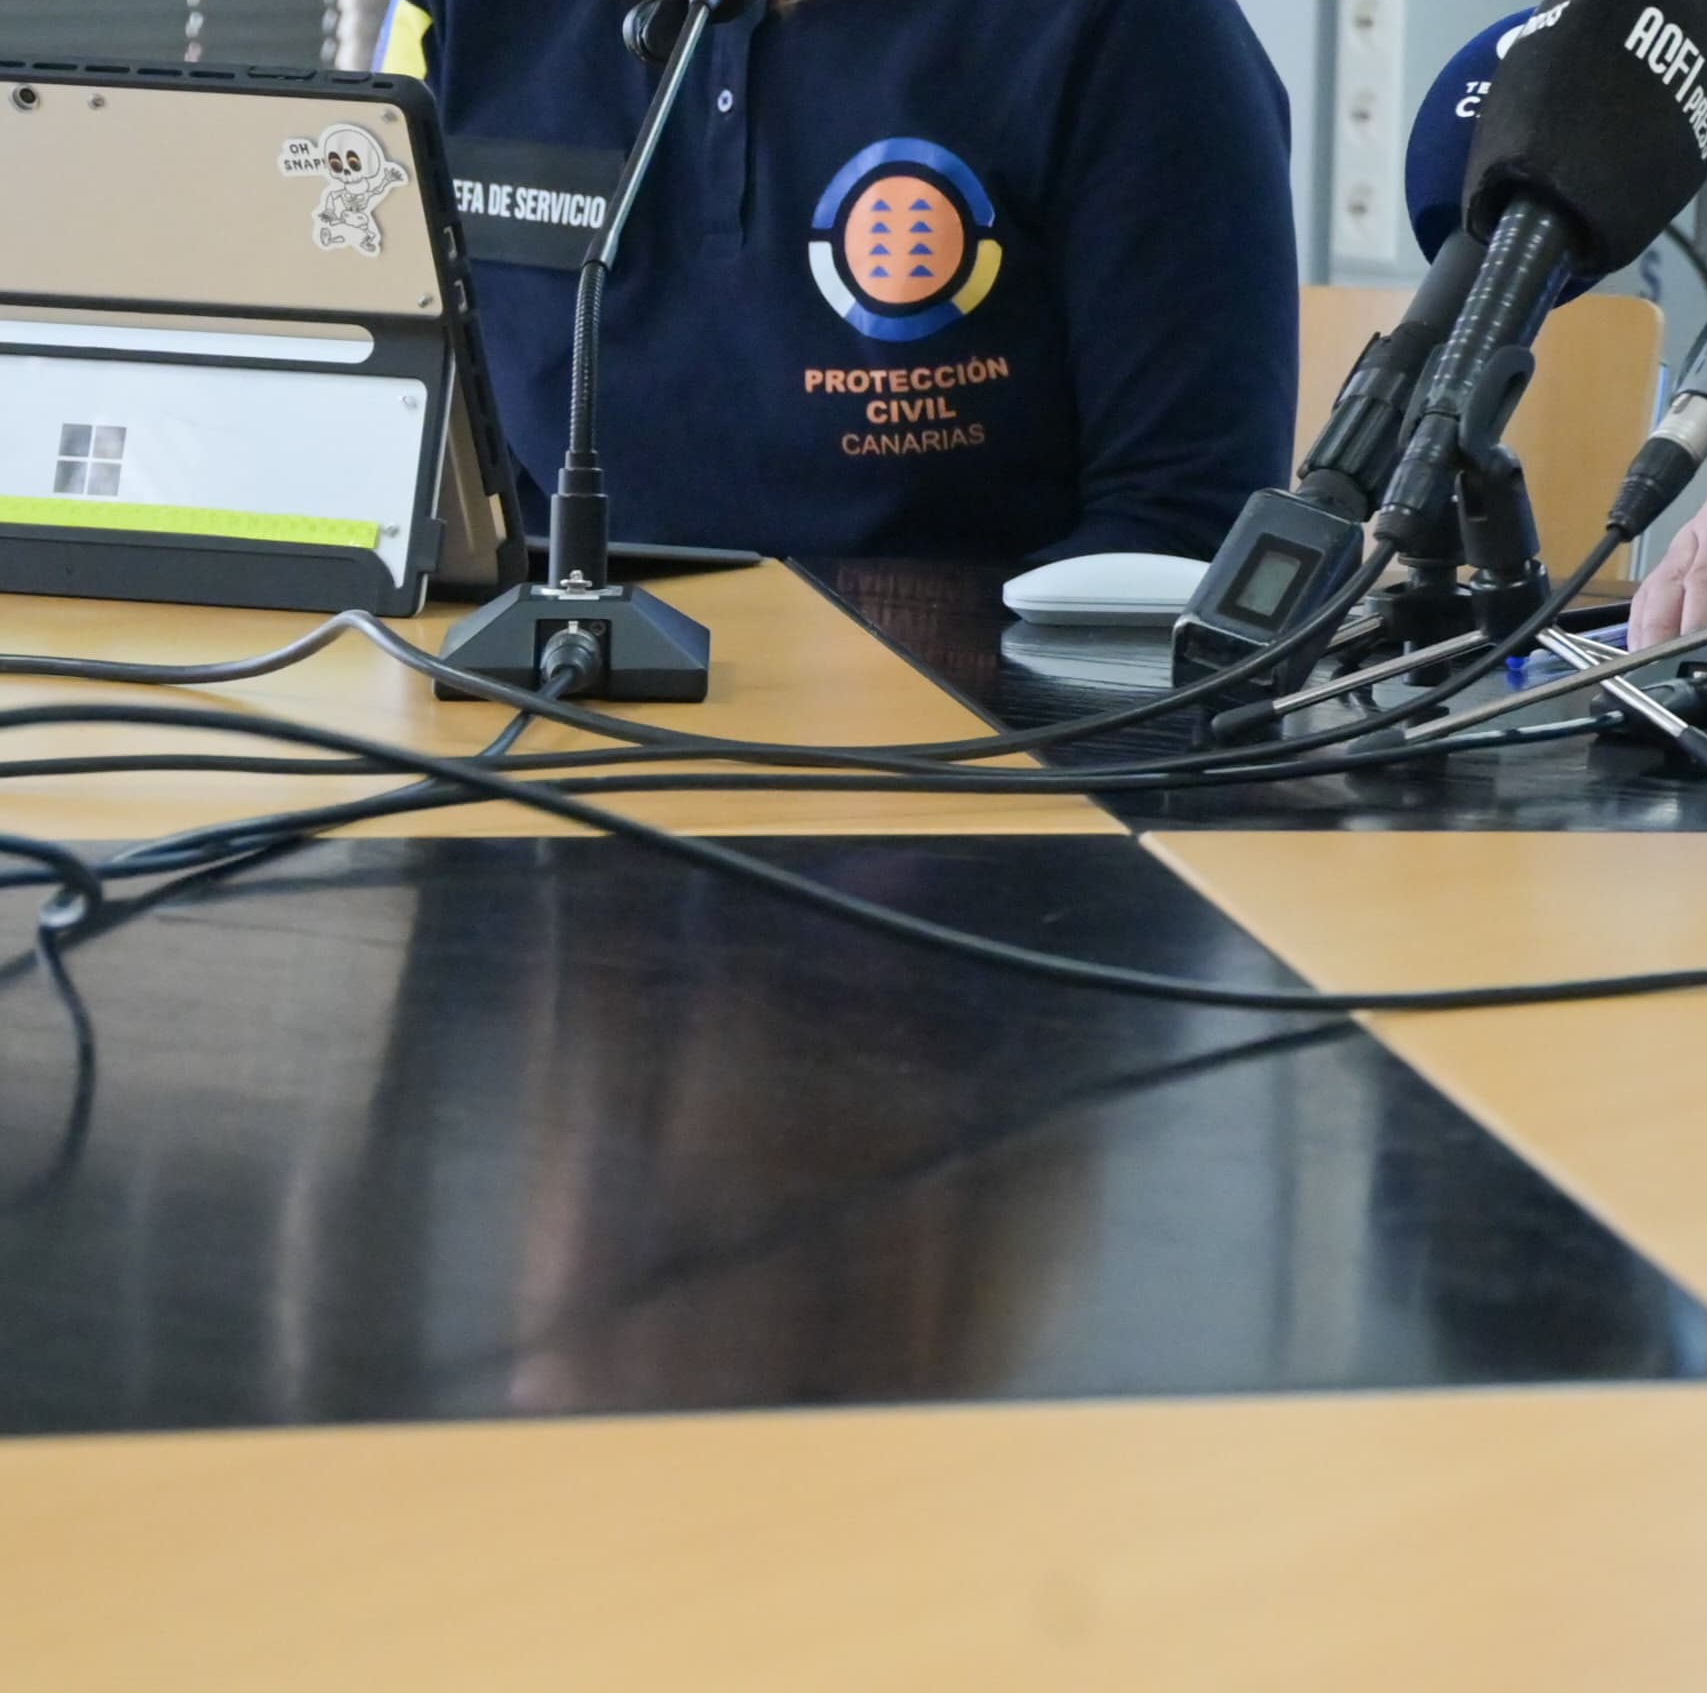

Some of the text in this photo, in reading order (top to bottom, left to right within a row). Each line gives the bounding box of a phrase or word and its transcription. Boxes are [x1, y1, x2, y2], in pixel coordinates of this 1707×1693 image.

[289, 143, 310, 155] OH
[453, 179, 607, 229] EFA DE SERVICIO
[804, 356, 1009, 394] PROTECCIÓN
[866, 396, 957, 424] CIVIL
[841, 423, 985, 456] CANARIAS
